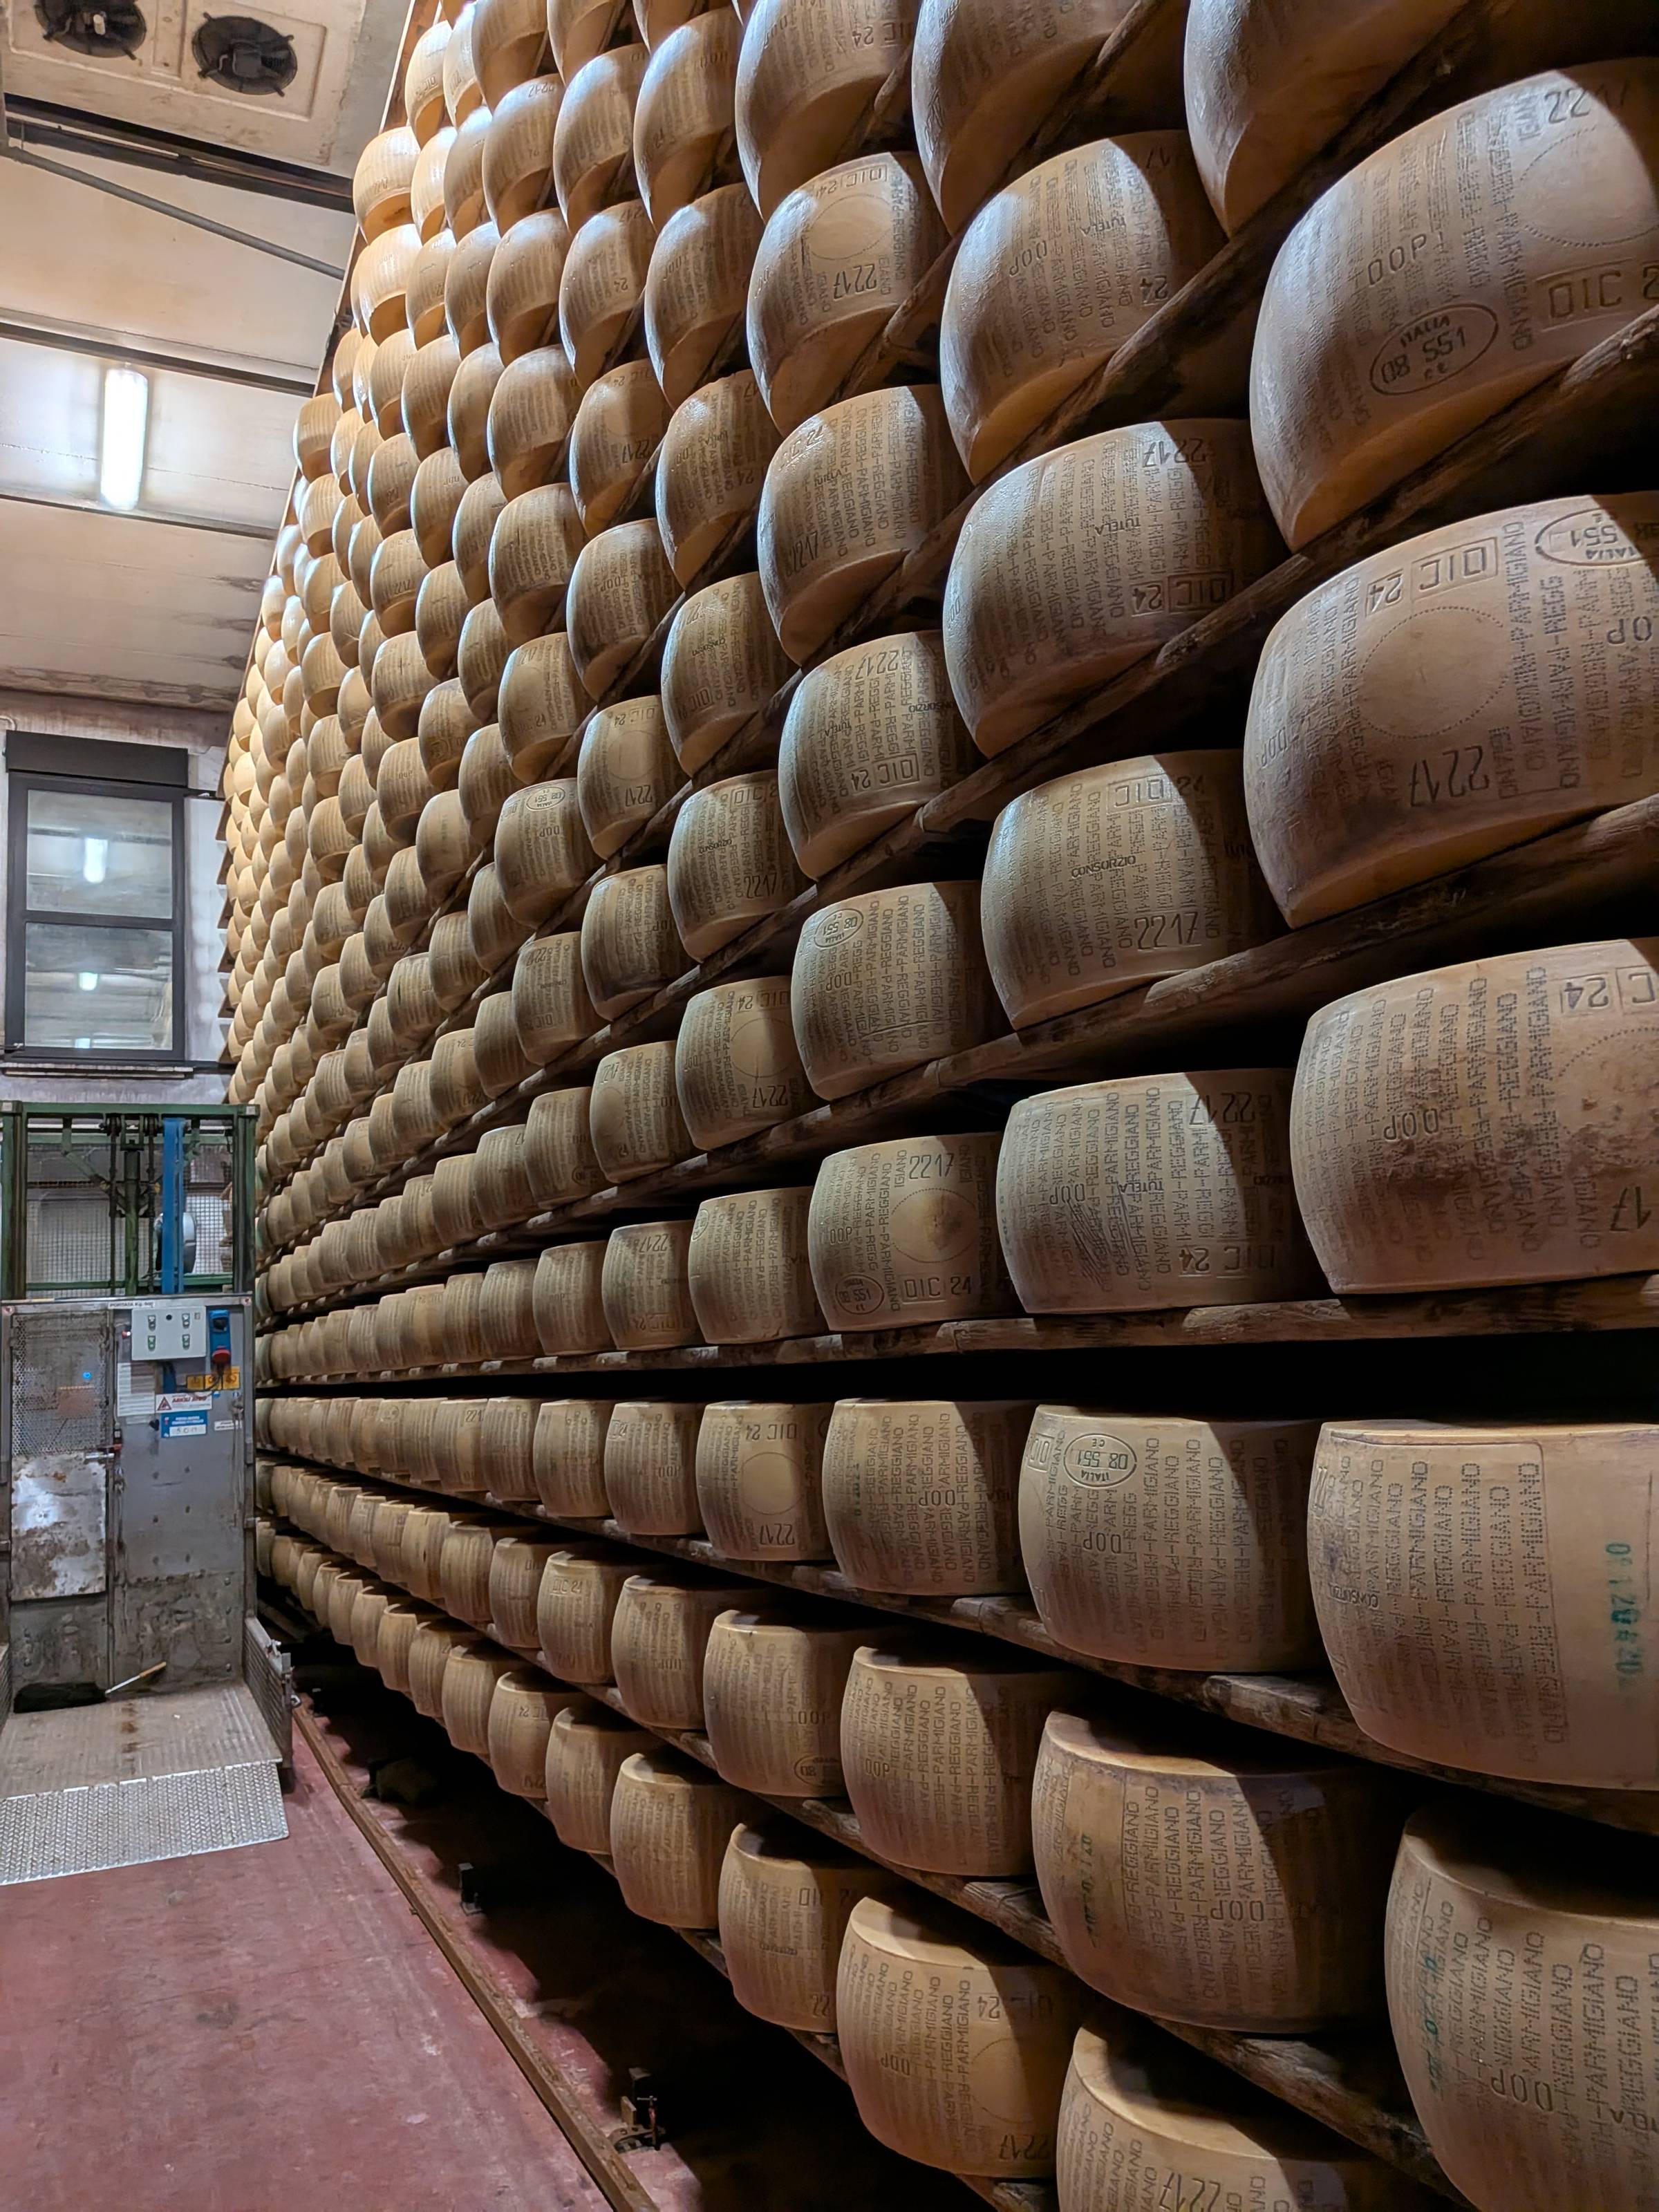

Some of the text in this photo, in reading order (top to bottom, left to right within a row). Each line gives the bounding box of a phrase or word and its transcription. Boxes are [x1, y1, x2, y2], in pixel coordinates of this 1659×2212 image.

[834, 263, 877, 301] 2217
[1548, 270, 1622, 319] DIC
[1423, 330, 1467, 362] 551
[1368, 547, 1488, 612] DIC 24
[1132, 583, 1163, 611] 24
[851, 760, 913, 791] DIC 24
[625, 785, 653, 807] 2217
[1114, 779, 1165, 807] DIC
[1071, 854, 1136, 879] CONSORZIO
[743, 872, 778, 899] 2217
[1134, 912, 1199, 950] 2217
[825, 971, 852, 992] DOP
[1564, 977, 1608, 1009] 24
[752, 1085, 787, 1109] 2217
[1384, 1107, 1440, 1141] DOP
[909, 1152, 955, 1180] 2217
[830, 1226, 852, 1245] DOP
[1179, 1248, 1210, 1272] 24
[904, 1277, 941, 1298] DIC
[1078, 1450, 1129, 1470] 08 551
[1080, 1470, 1110, 1482] ITALIA
[918, 1490, 955, 1507] DOP
[1143, 1437, 1160, 1543] PARMIGIANO
[1164, 1455, 1180, 1544] REGGIANO
[1186, 1438, 1201, 1546] PARMIGIANO
[760, 1523, 795, 1546] 2217
[1082, 1532, 1122, 1554] DOP
[1434, 1484, 1454, 1605] REGGIANO
[1461, 1462, 1485, 1606] PARMIGIANO
[1489, 1485, 1515, 1608] REGGIANO
[1518, 1462, 1549, 1609] PARMIGIANO
[933, 1686, 946, 1774] PARMIGIANO
[949, 1701, 962, 1775] REGGIANO
[1165, 1806, 1180, 1903] REGGIANO
[1186, 1790, 1207, 1909] PARMIGIANO
[1210, 1900, 1264, 1922] DOP
[977, 1996, 1000, 2020] 24
[1584, 1942, 1605, 2109] PARMIGIANO
[1491, 2069, 1553, 2112] DOP
